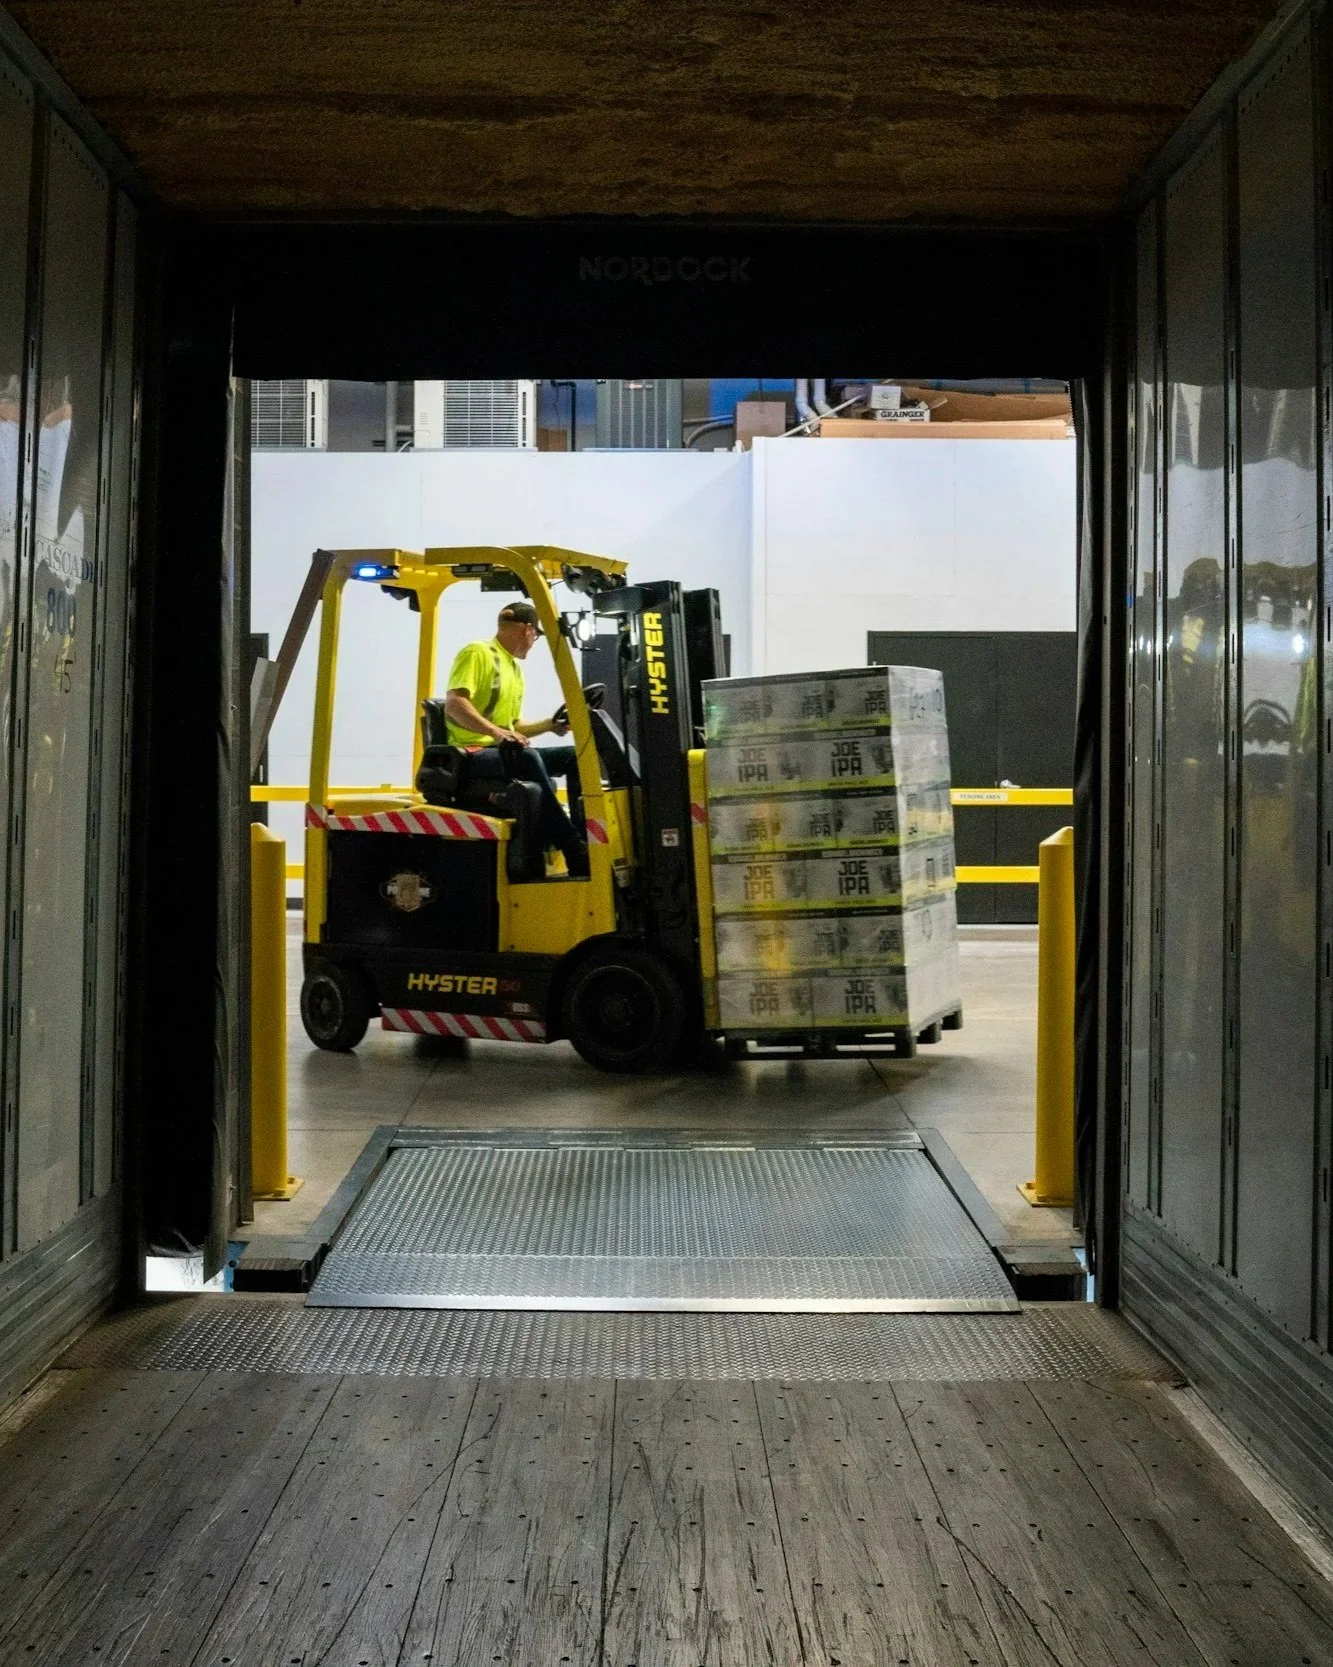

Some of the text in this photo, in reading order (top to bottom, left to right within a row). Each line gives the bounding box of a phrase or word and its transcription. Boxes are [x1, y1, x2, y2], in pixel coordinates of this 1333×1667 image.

[577, 255, 757, 285] NORDOCK
[880, 410, 925, 418] GRAINGER
[644, 612, 669, 715] HYSTER
[738, 748, 766, 763] JOE
[831, 741, 861, 757] JOE
[738, 764, 768, 782] IPA
[831, 757, 862, 777] IPA
[873, 810, 894, 821] JOE
[810, 824, 831, 837] IPA
[873, 821, 896, 834] IPA
[744, 864, 773, 880] JOE
[839, 860, 868, 876] JOE
[744, 879, 775, 900] IPA
[839, 876, 870, 895] IPA
[407, 973, 498, 995] HYSTER
[845, 979, 876, 994] JOE
[750, 997, 780, 1016] IPA
[845, 995, 877, 1014] IPA
